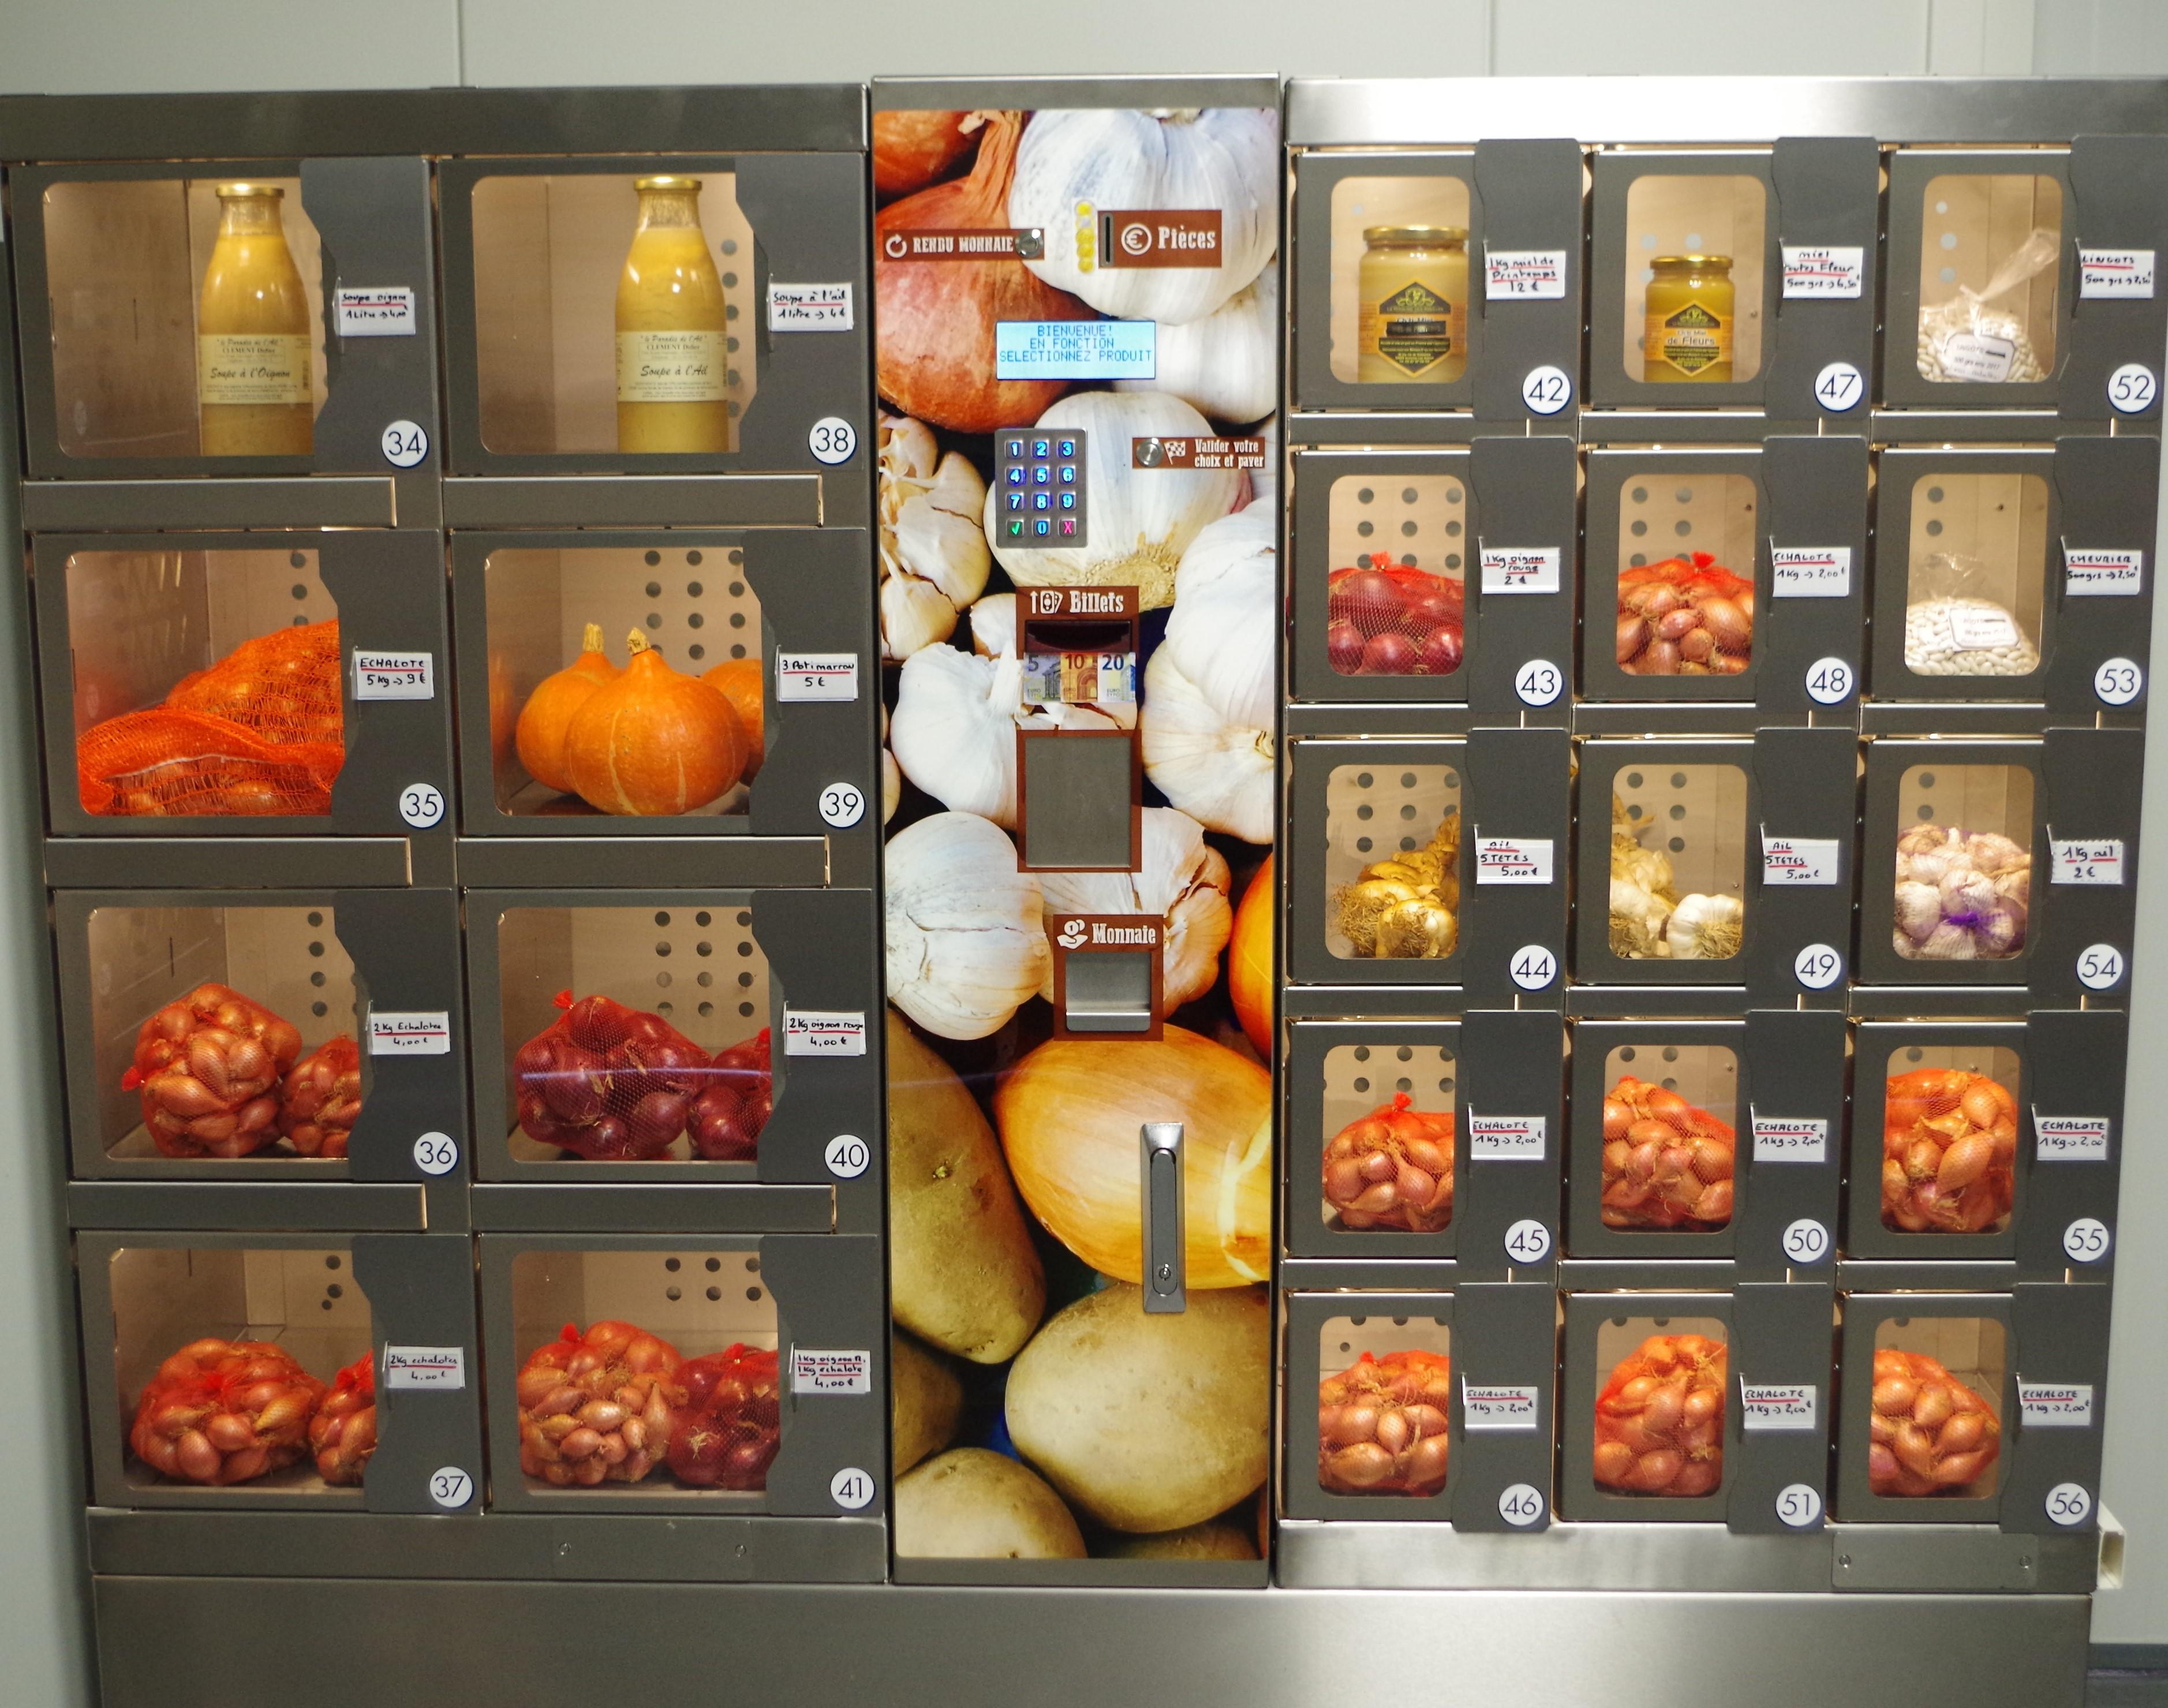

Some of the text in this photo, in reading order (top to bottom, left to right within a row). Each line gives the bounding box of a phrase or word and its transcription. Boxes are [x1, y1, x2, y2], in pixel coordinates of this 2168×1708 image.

[1158, 226, 1215, 249] Pièces
[913, 237, 1014, 253] RENDU MONNAIE
[1513, 258, 1537, 267] miel
[1821, 263, 1853, 272] Fleur
[1511, 283, 1524, 292] 12
[343, 294, 369, 304] Soupe
[773, 293, 802, 306] Soupe
[1038, 326, 1112, 337] BIENVENUE!
[1030, 338, 1114, 349] EN FONCTION
[1000, 350, 1152, 361] SELECTIONNEZ PRODUIT
[211, 368, 236, 380] Soupe
[641, 365, 671, 379] Soupe
[675, 366, 681, 375] à
[1528, 377, 1563, 401] 42
[1821, 375, 1856, 398] 47
[2115, 375, 2150, 400] 52
[388, 431, 422, 456] 34
[816, 427, 848, 453] 38
[1195, 440, 1258, 453] Valider votre
[1012, 443, 1072, 457] 1 2 3
[1195, 455, 1264, 469] choix et payer
[1010, 469, 1072, 483] 4 5 6
[1010, 494, 1072, 509] 7 8 9
[1037, 523, 1046, 535] 0
[1508, 555, 1544, 564] oignon
[1774, 552, 1832, 561] ECHALOTE
[1505, 576, 1512, 584] 2
[1070, 590, 1124, 613] Billets
[361, 659, 424, 668] ECHALOTE
[783, 660, 788, 670] 3
[1029, 655, 1038, 671] 5
[1066, 655, 1085, 669] 10
[1102, 654, 1124, 670] 20
[368, 675, 373, 685] 5
[408, 674, 414, 683] 9
[805, 678, 813, 687] 5
[1520, 670, 1554, 694] 43
[1810, 668, 1845, 692] 48
[2100, 669, 2135, 693] 53
[406, 793, 438, 817] 35
[825, 792, 858, 817] 39
[2094, 846, 2113, 857] ail
[1776, 857, 1804, 865] TETES
[2074, 867, 2095, 877] 2 €
[1092, 923, 1156, 944] Monnaie
[1515, 955, 1550, 978] 44
[1800, 954, 1834, 977] 49
[2082, 954, 2117, 978] 54
[812, 1021, 840, 1031] oignon
[1756, 1123, 1817, 1131] ECHALOTE
[2042, 1122, 2105, 1130] ECHALOTE
[420, 1141, 452, 1165] 36
[831, 1144, 865, 1168] 40
[1509, 1229, 1543, 1252] 45
[1788, 1228, 1822, 1252] 50
[2067, 1228, 2103, 1251] 55
[820, 1355, 853, 1363] oignon
[435, 1475, 465, 1498] 37
[838, 1477, 862, 1499] 41
[1504, 1494, 1537, 1515] 46
[1782, 1494, 1809, 1516] 51
[2051, 1493, 2083, 1515] 56
